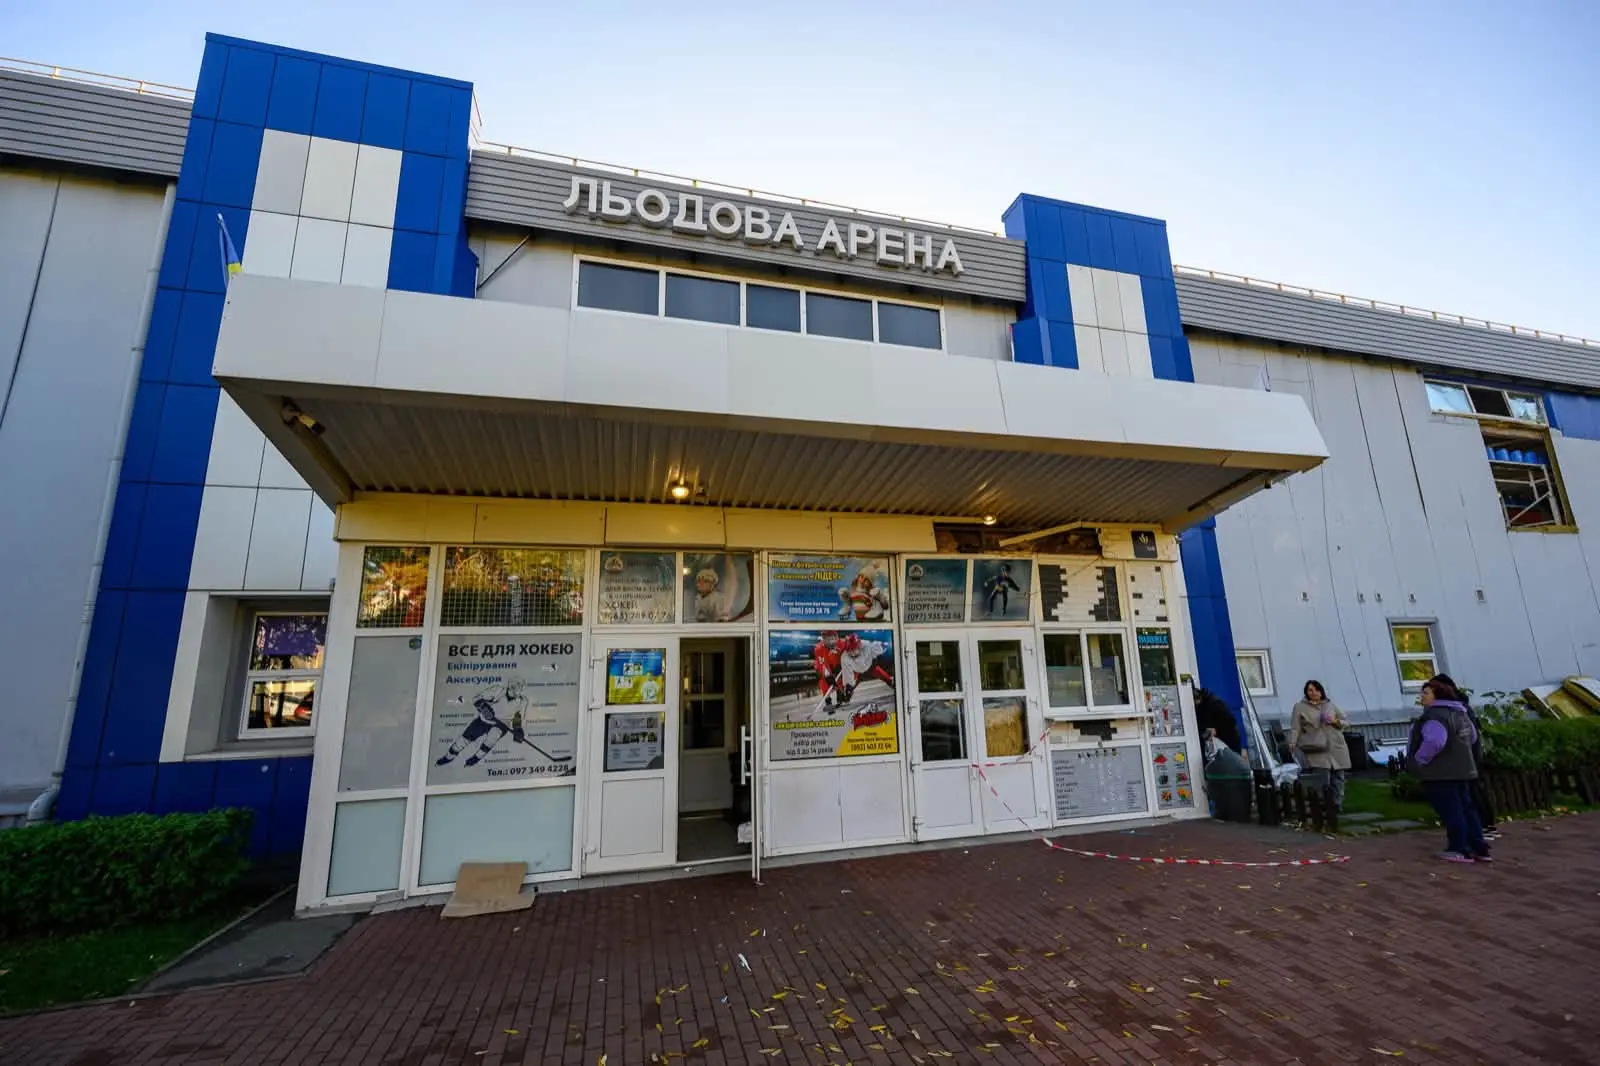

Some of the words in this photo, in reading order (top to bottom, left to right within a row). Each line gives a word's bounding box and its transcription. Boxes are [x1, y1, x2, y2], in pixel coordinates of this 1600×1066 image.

[563, 175, 804, 252] ЛЬОДОВА
[814, 217, 965, 277] АРЕНА
[448, 644, 479, 657] ВСЕ
[482, 643, 515, 659] ДЛЯ
[519, 643, 574, 656] ХОКЕЮ
[447, 662, 518, 672] Екіпірування
[446, 675, 502, 685] Аксесуари
[510, 767, 527, 776] 097
[529, 765, 545, 774] 349
